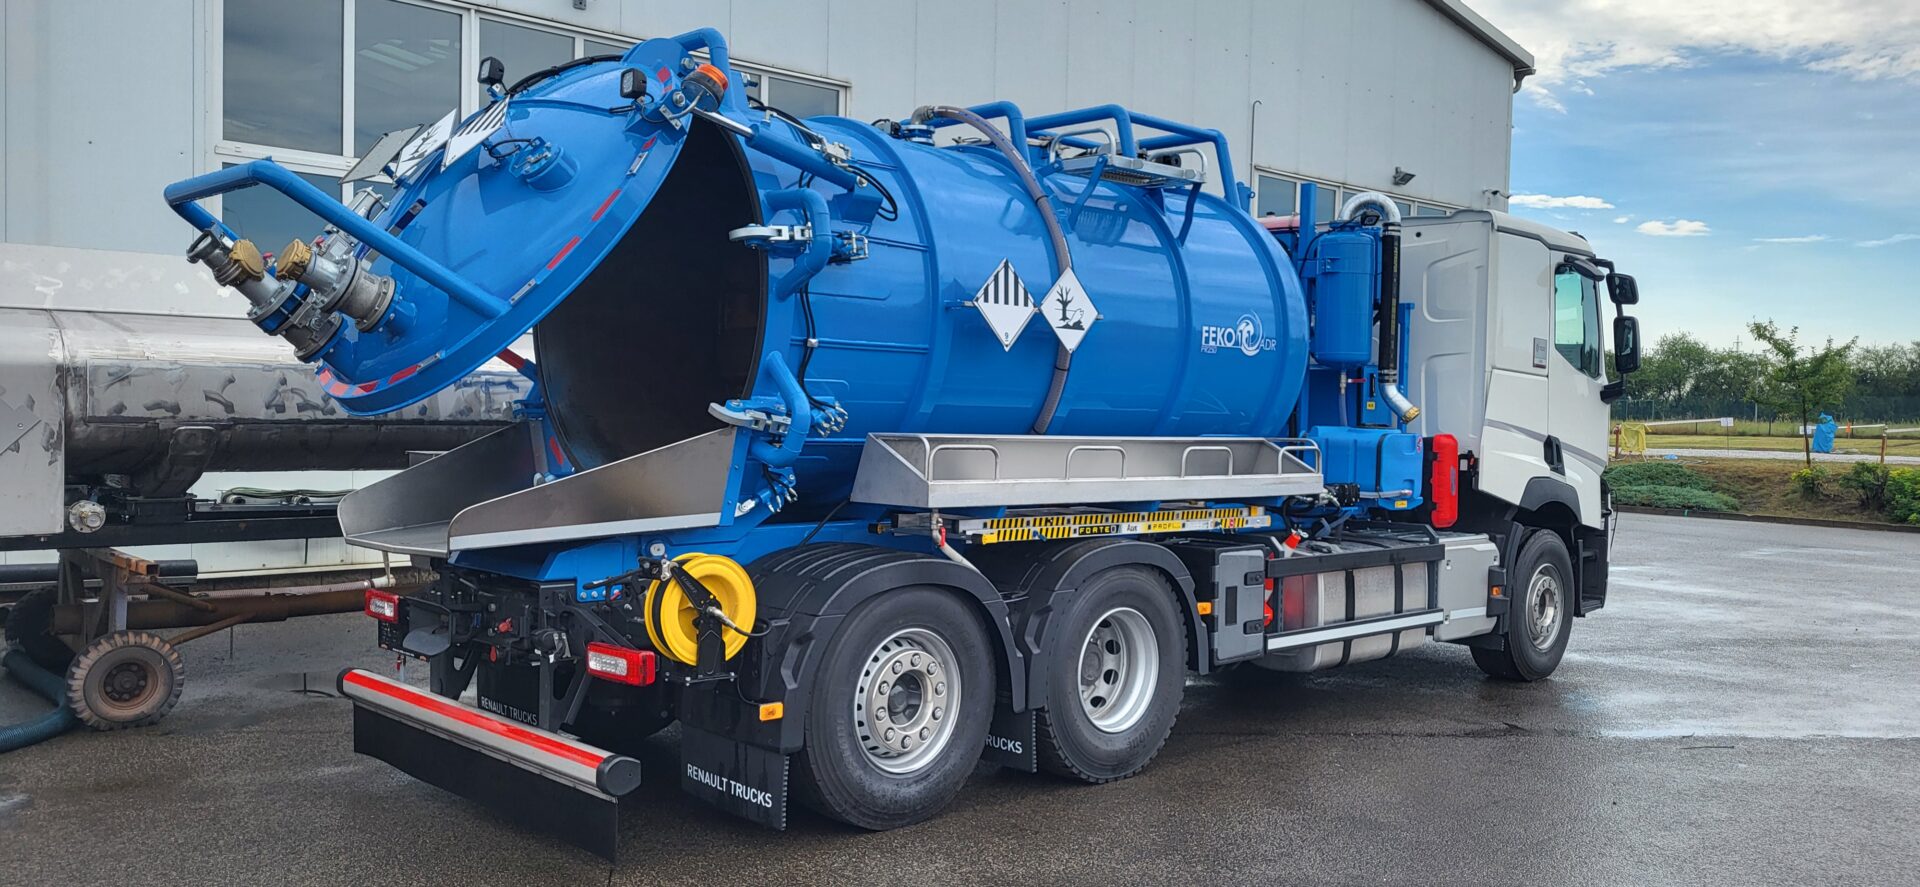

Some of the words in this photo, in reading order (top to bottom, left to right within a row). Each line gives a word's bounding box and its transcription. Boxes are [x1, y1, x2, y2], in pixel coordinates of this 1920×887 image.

[1201, 326, 1236, 347] FEKO
[1260, 336, 1277, 351] ADR
[1079, 525, 1111, 536] FORTE
[480, 695, 508, 717] RENAULT
[508, 705, 539, 726] TRUCKS
[985, 733, 1023, 755] RUCKS
[686, 762, 729, 793] RENAULT
[729, 779, 773, 809] TRUCKS
